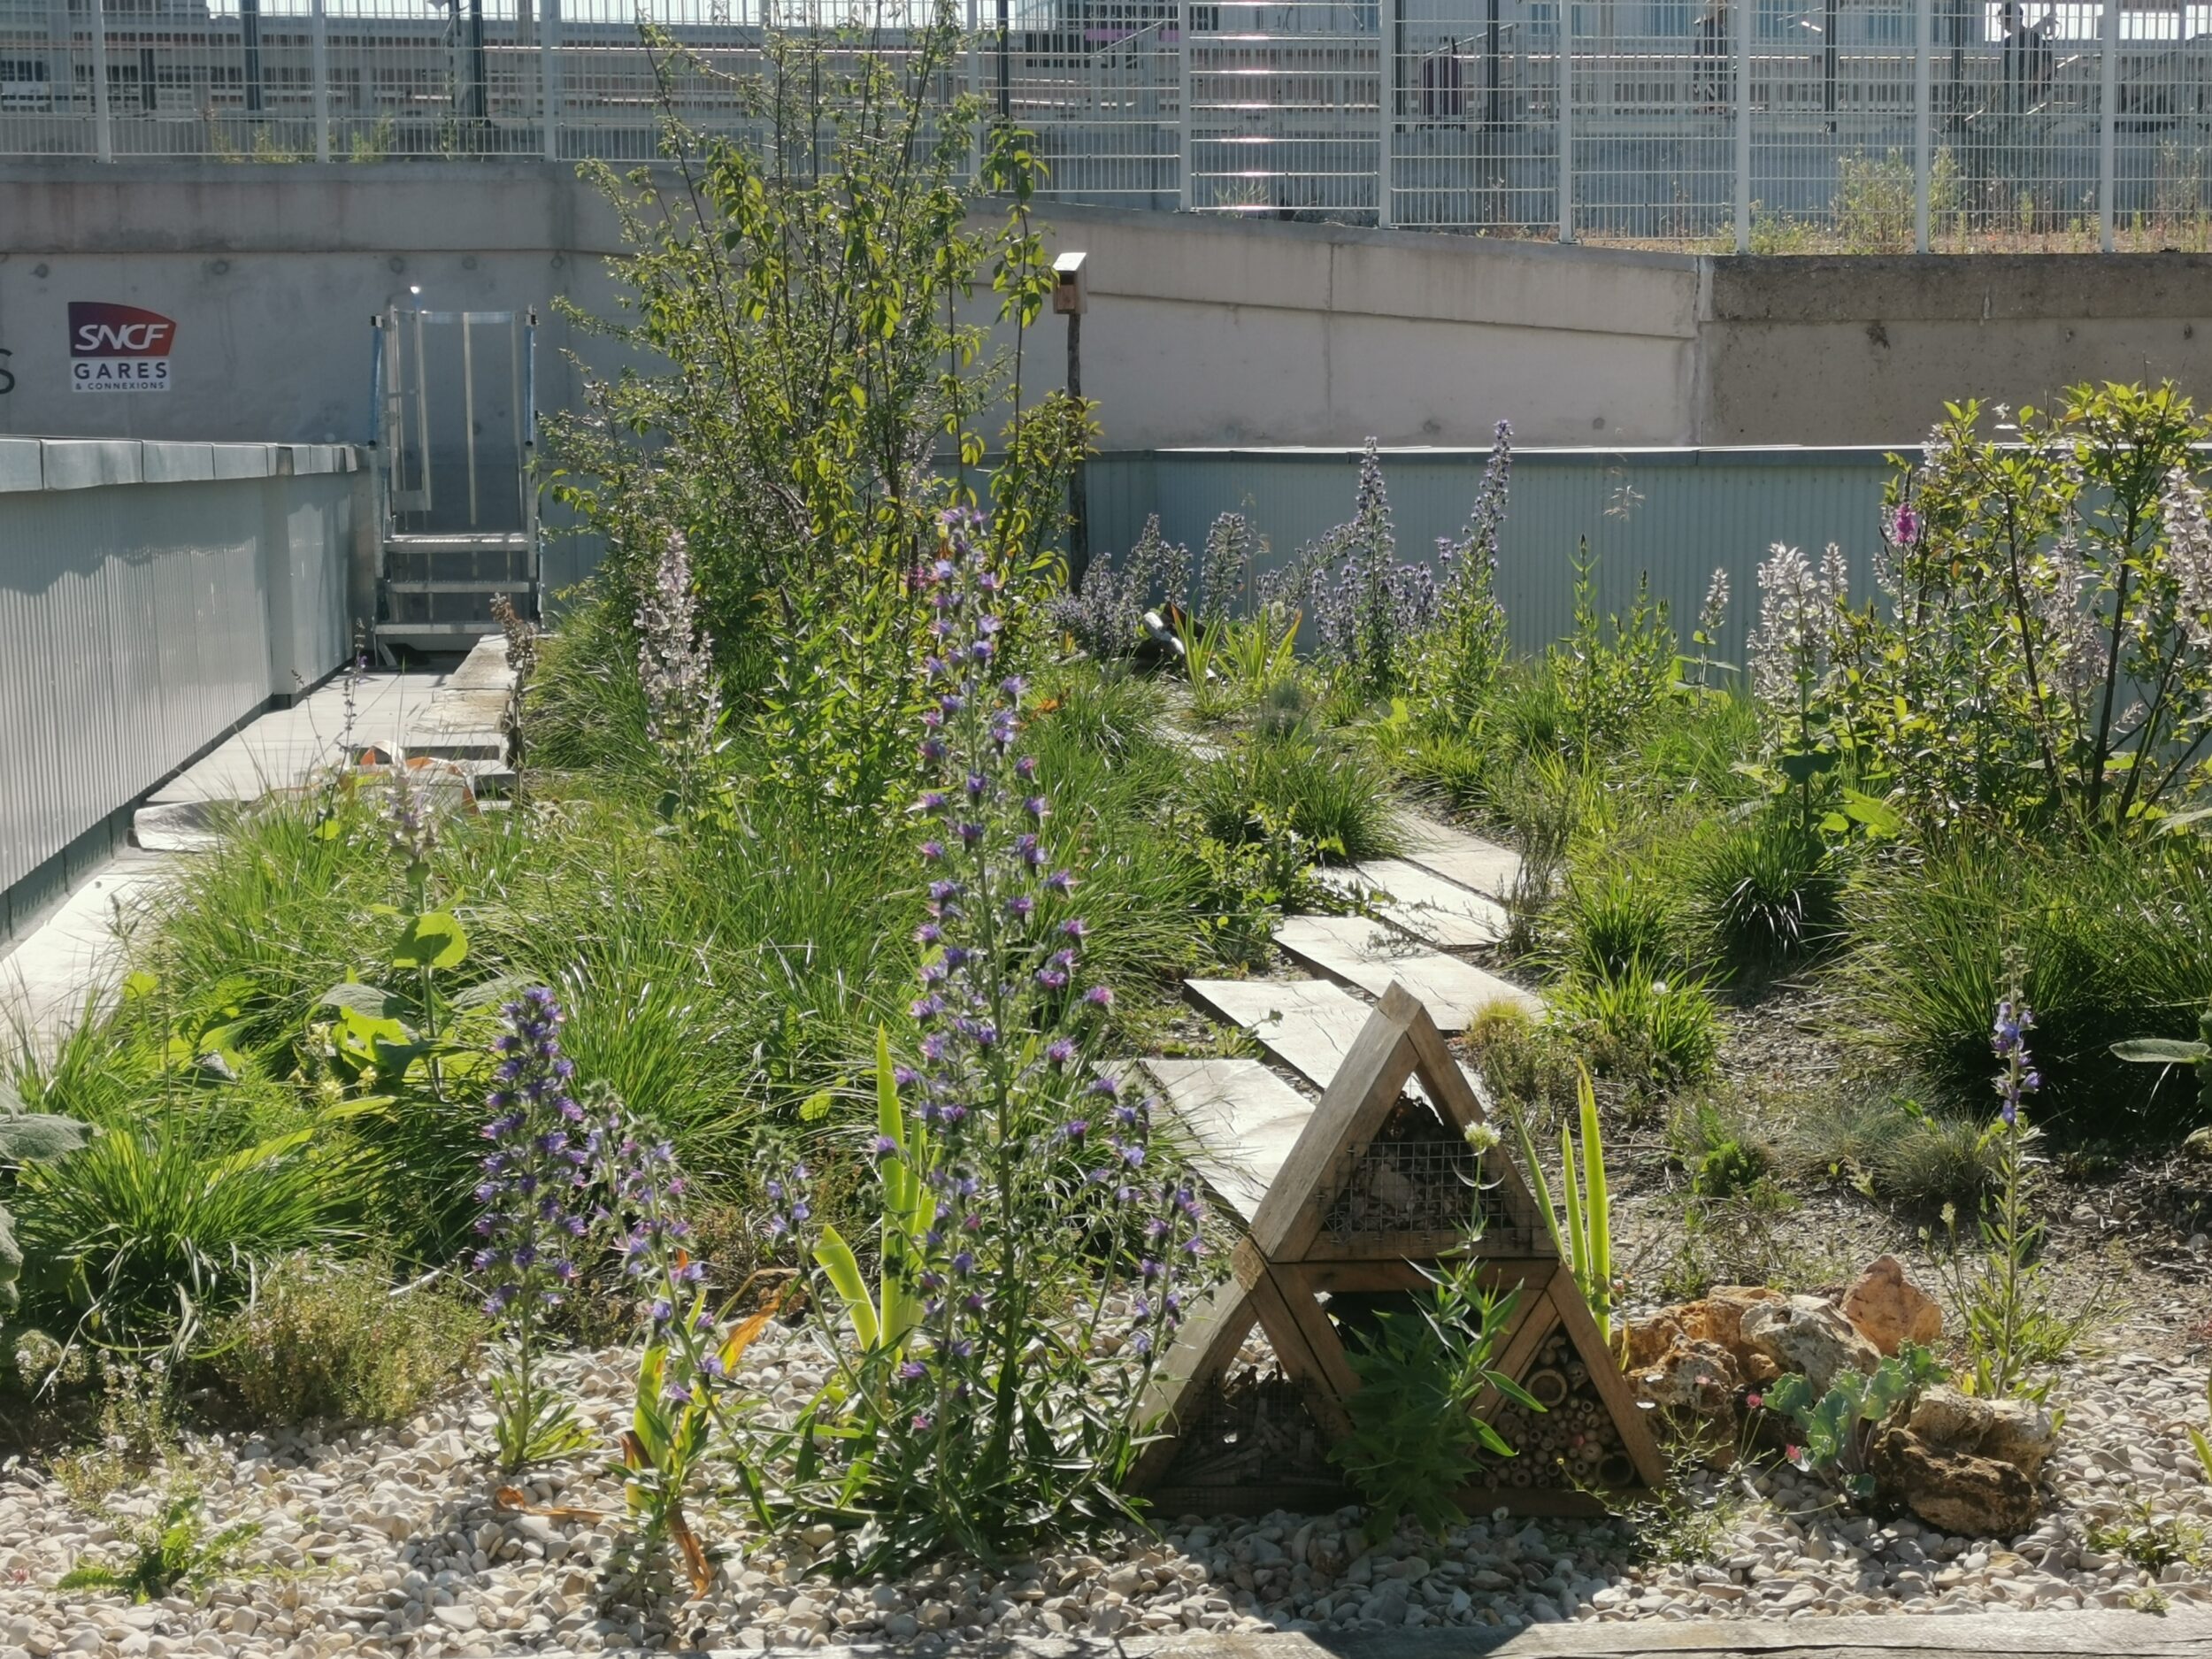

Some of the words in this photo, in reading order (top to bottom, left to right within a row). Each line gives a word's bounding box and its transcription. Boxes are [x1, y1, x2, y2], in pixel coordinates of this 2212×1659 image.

[74, 323, 169, 350] SNCF
[74, 362, 167, 380] GARES
[88, 381, 165, 390] CONNEXIONS
